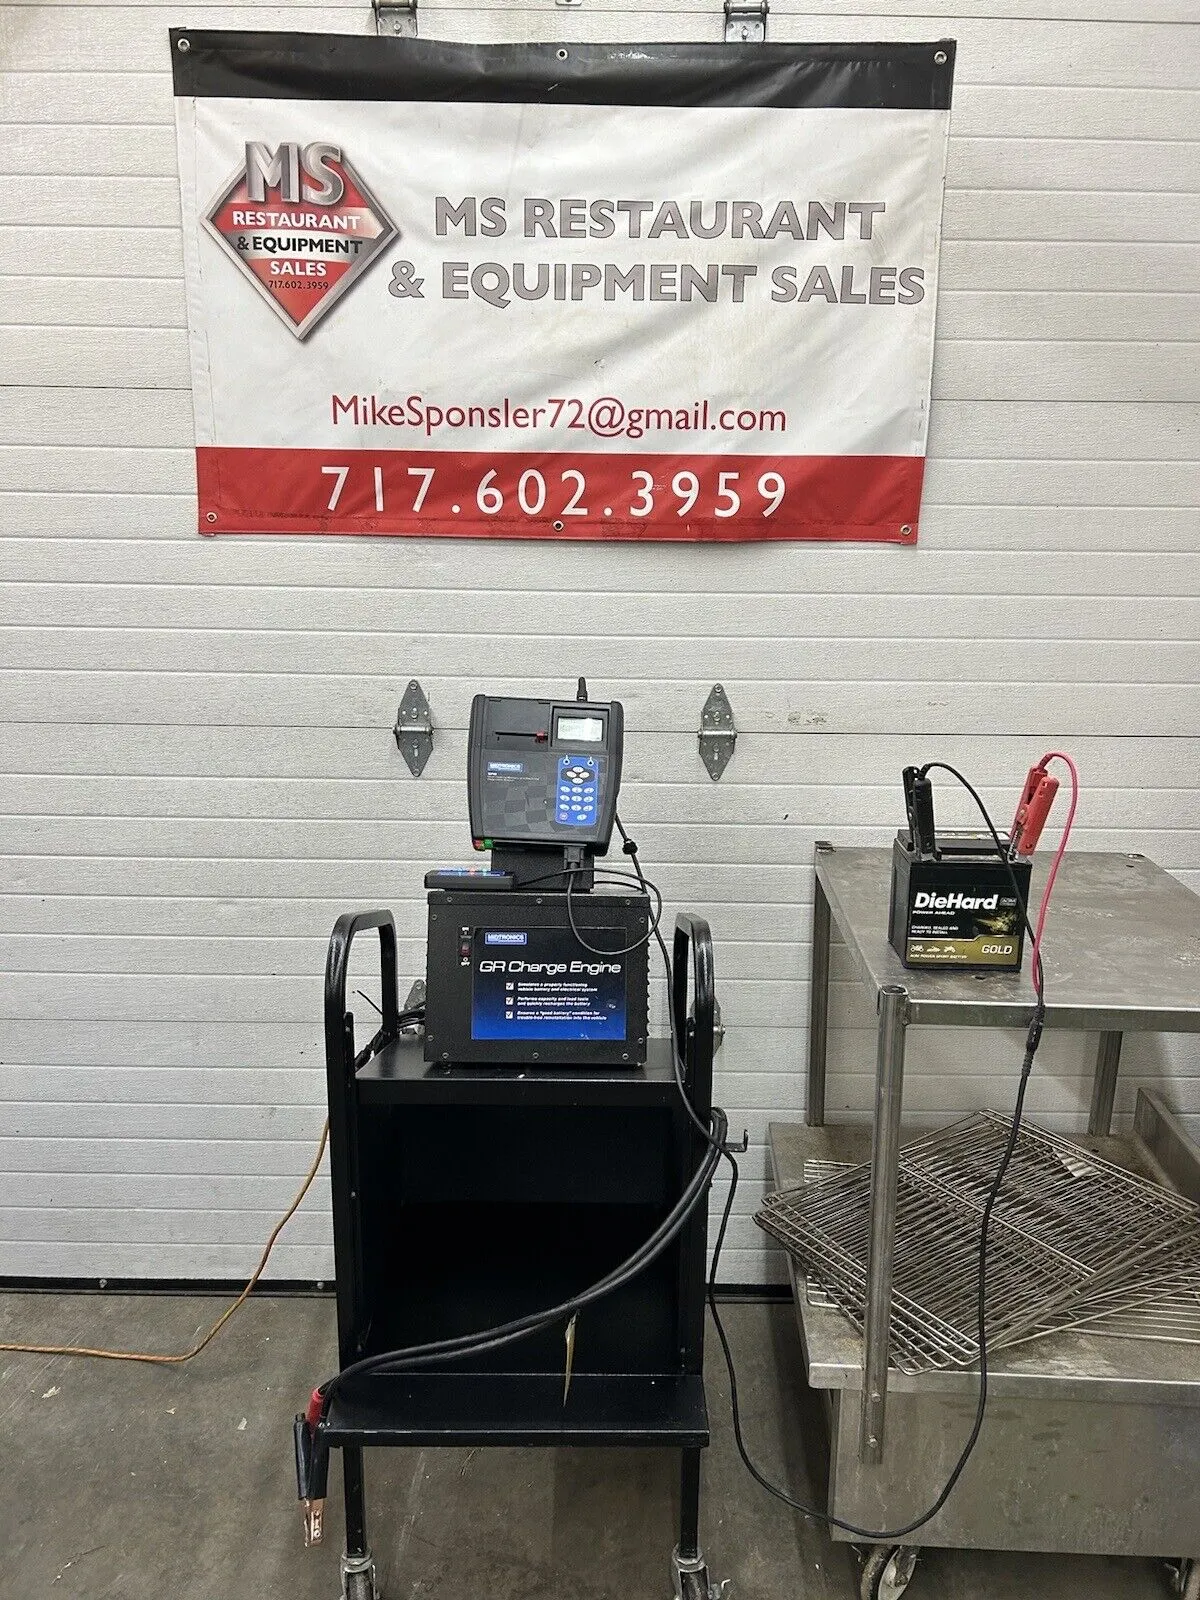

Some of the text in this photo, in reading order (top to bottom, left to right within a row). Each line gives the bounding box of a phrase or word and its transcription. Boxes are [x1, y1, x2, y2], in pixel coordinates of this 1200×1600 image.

[245, 141, 344, 206] MS
[232, 211, 361, 230] RESTAURANT
[434, 196, 886, 241] MS RESTAURANT
[237, 236, 363, 254] & EQUIPMENT
[270, 260, 327, 277] SALES
[268, 280, 329, 290] 717.602.3959
[388, 260, 925, 308] & EQUIPMENT SALES
[331, 395, 787, 438] MikeSponsler72@gmail.com
[321, 466, 787, 518] 717.602.3959
[914, 892, 999, 910] DieHard
[981, 945, 1013, 955] GOLD
[479, 961, 622, 976] GR Charge Engine
